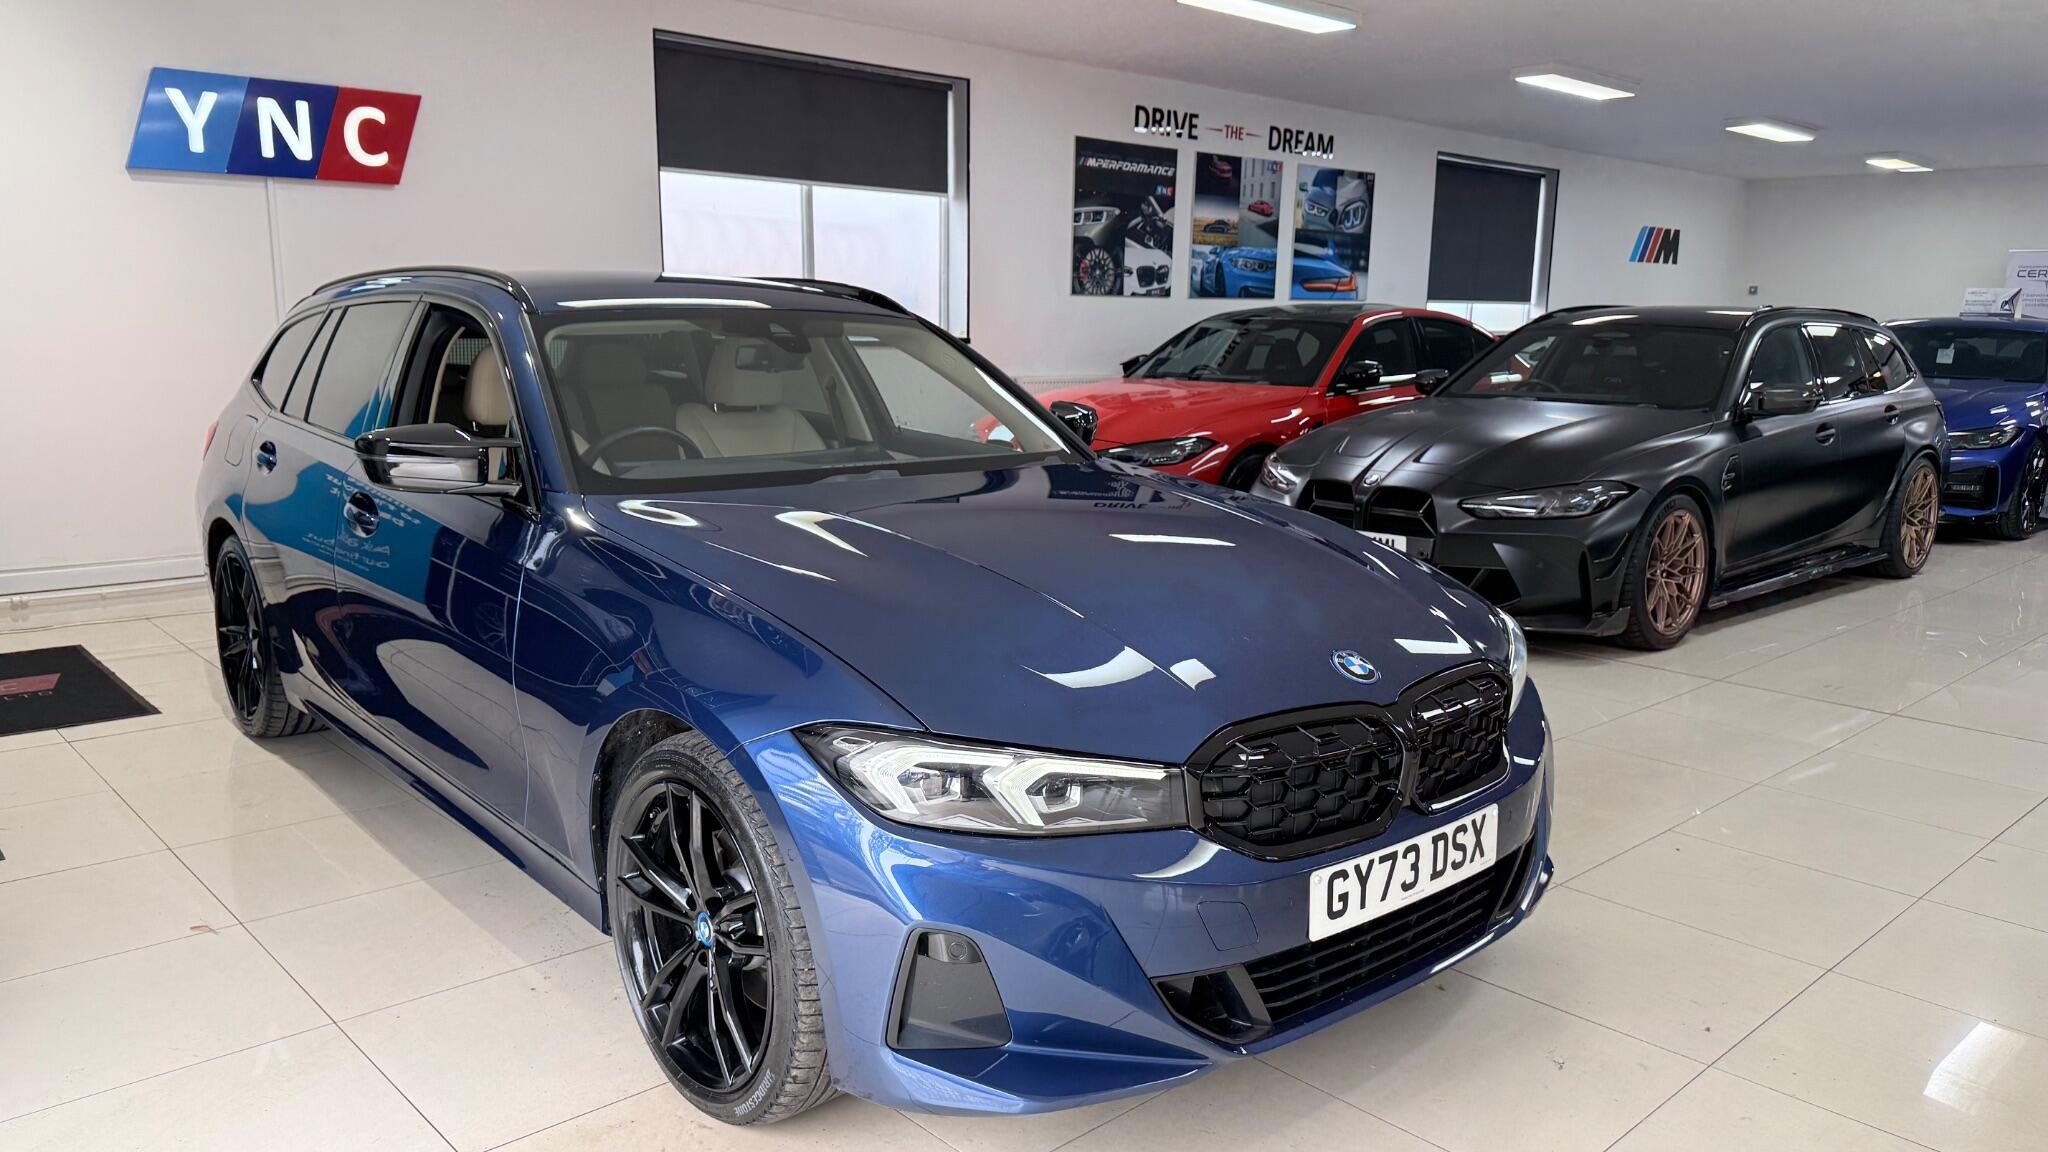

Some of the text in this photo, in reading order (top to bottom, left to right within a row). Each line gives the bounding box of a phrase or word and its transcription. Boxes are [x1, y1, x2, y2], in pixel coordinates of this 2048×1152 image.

[165, 87, 389, 167] YNC
[1134, 105, 1335, 158] DRIVE THE DREAM
[1326, 814, 1487, 921] GY73 DSX
